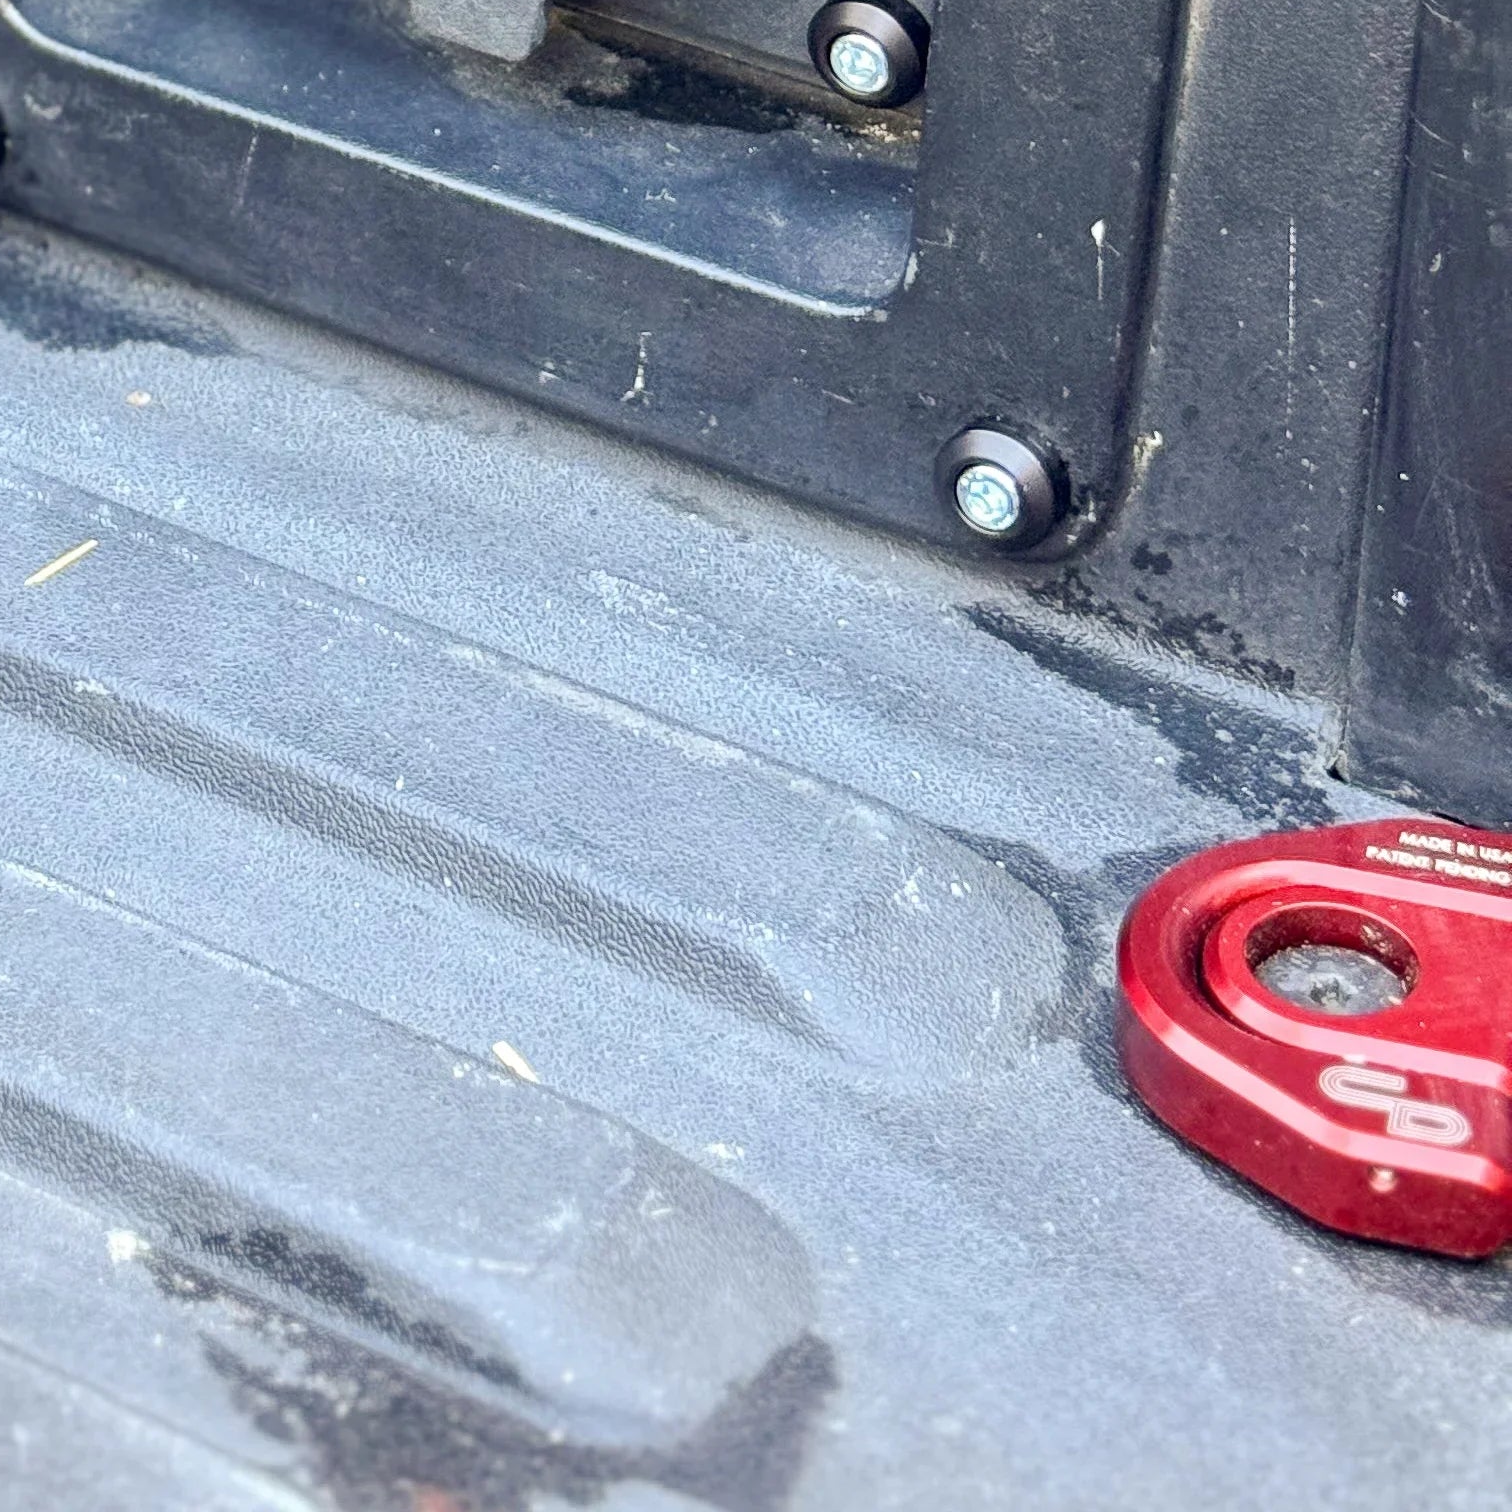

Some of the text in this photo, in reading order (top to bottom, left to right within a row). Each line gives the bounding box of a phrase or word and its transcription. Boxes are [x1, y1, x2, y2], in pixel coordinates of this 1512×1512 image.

[1365, 845, 1512, 887] PATENT PENDING
[1398, 831, 1512, 865] MADE IN USA
